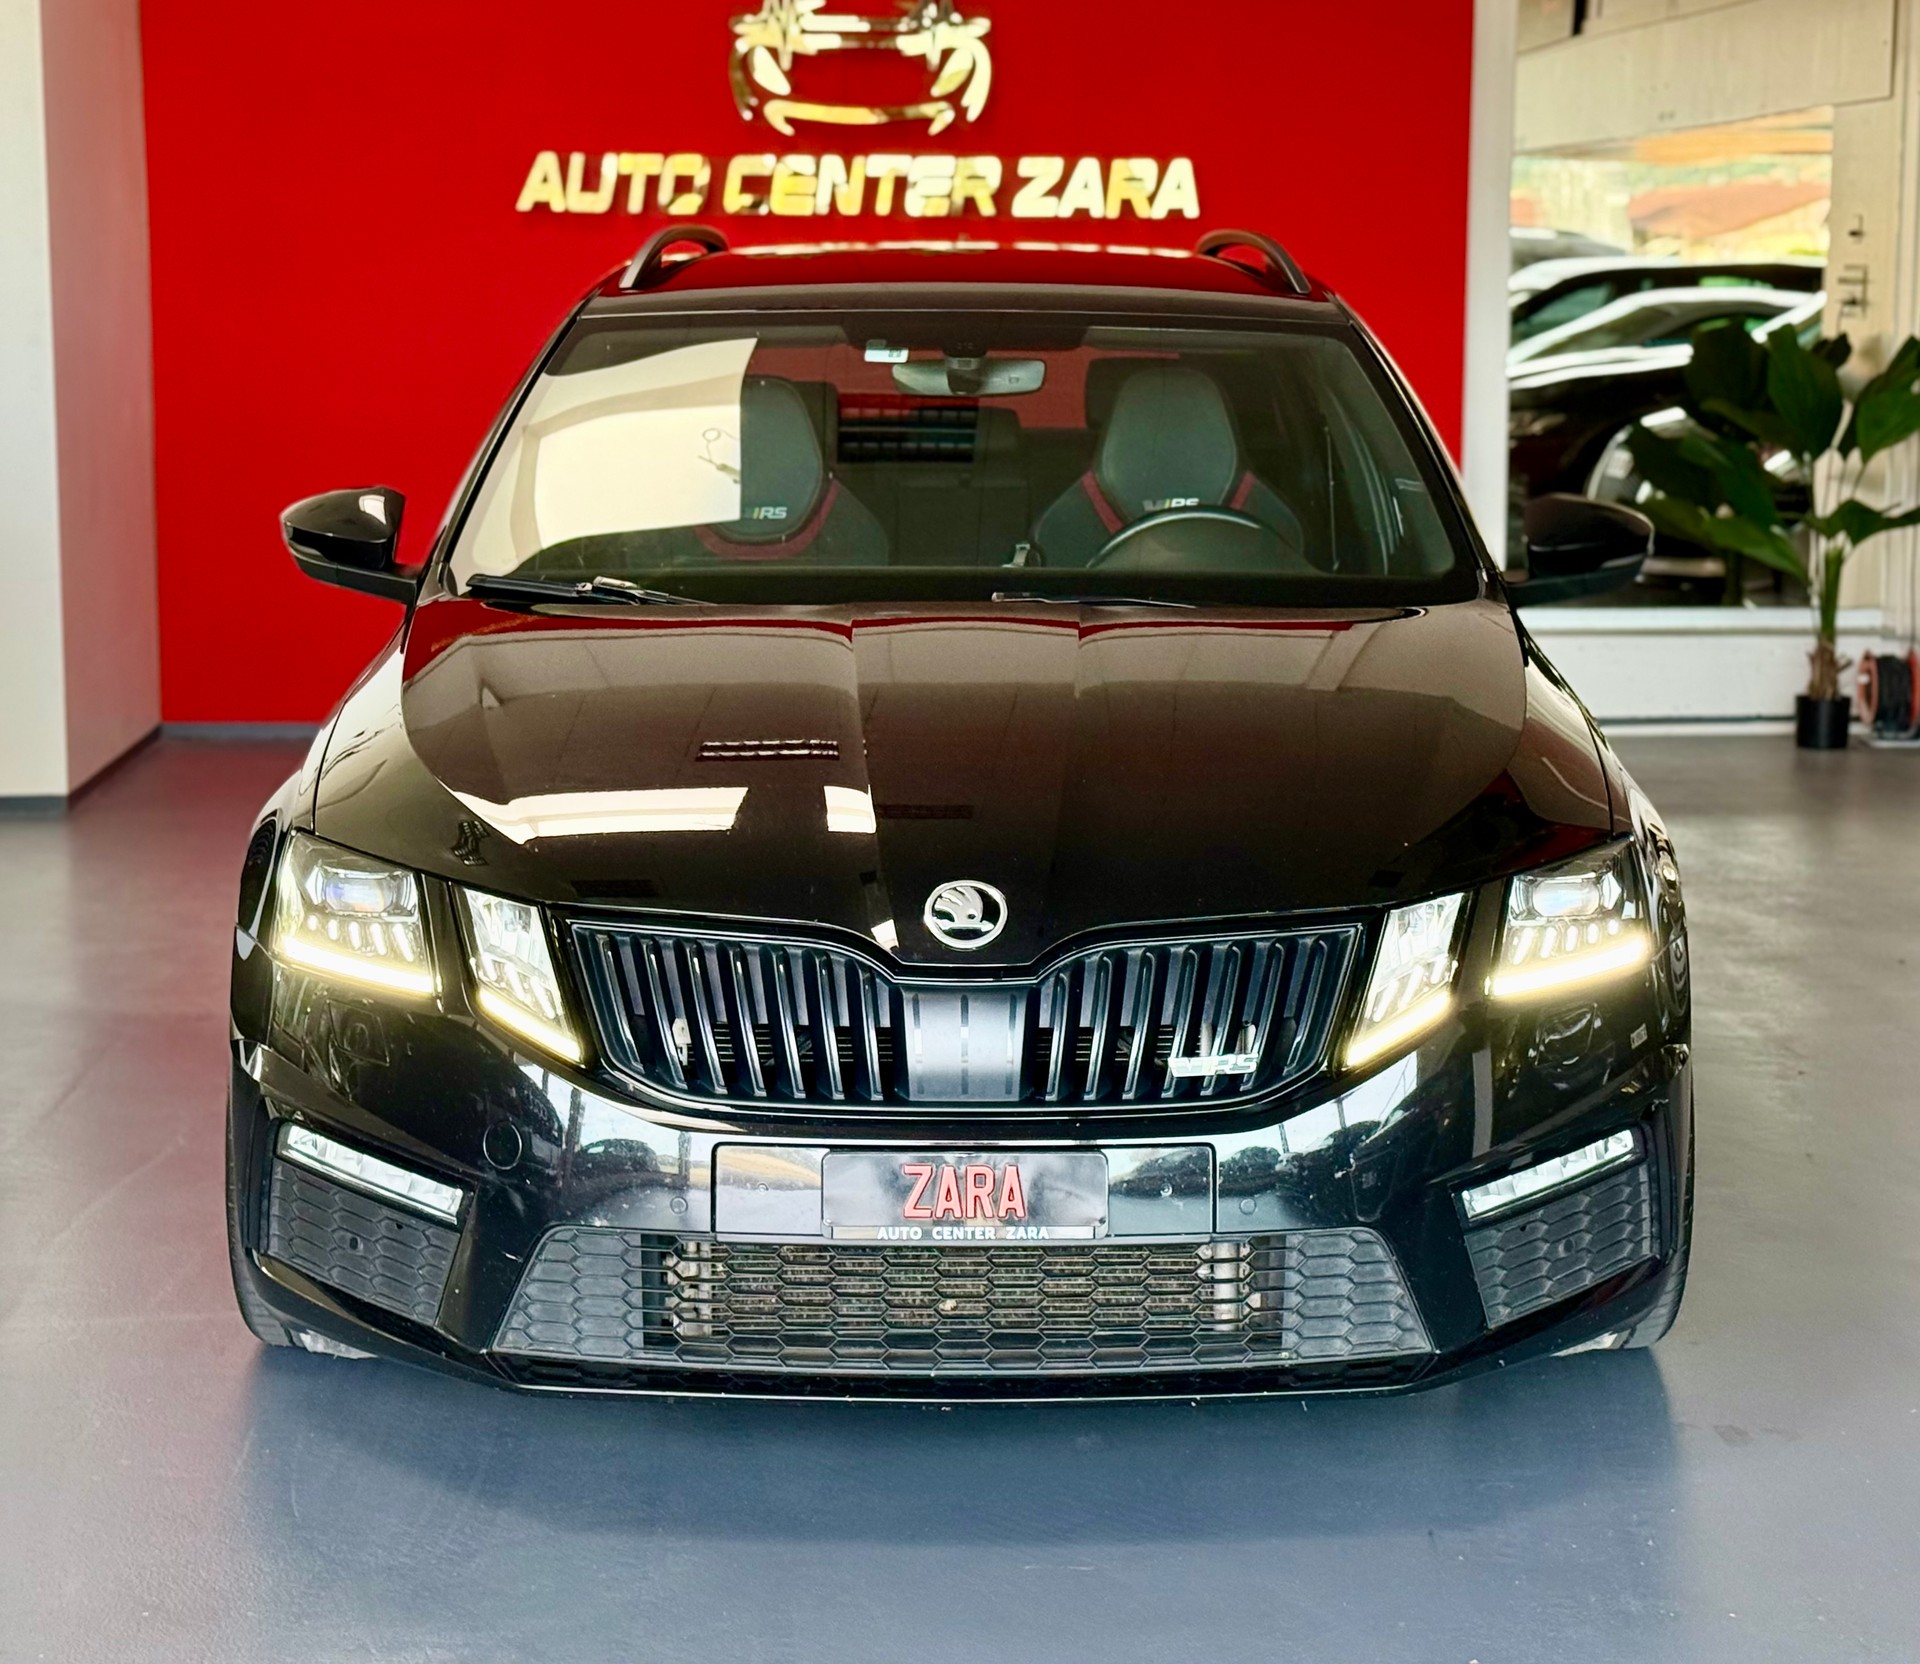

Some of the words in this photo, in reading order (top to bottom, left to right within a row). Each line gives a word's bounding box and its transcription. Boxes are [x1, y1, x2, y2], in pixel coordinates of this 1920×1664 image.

[515, 151, 710, 215] AUTO
[723, 154, 1002, 217] CENTER
[1011, 156, 1200, 219] ZARA
[902, 1163, 1026, 1219] ZARA
[877, 1226, 922, 1240] AUTO
[932, 1226, 996, 1240] CENTER
[1005, 1226, 1050, 1240] ZARA
